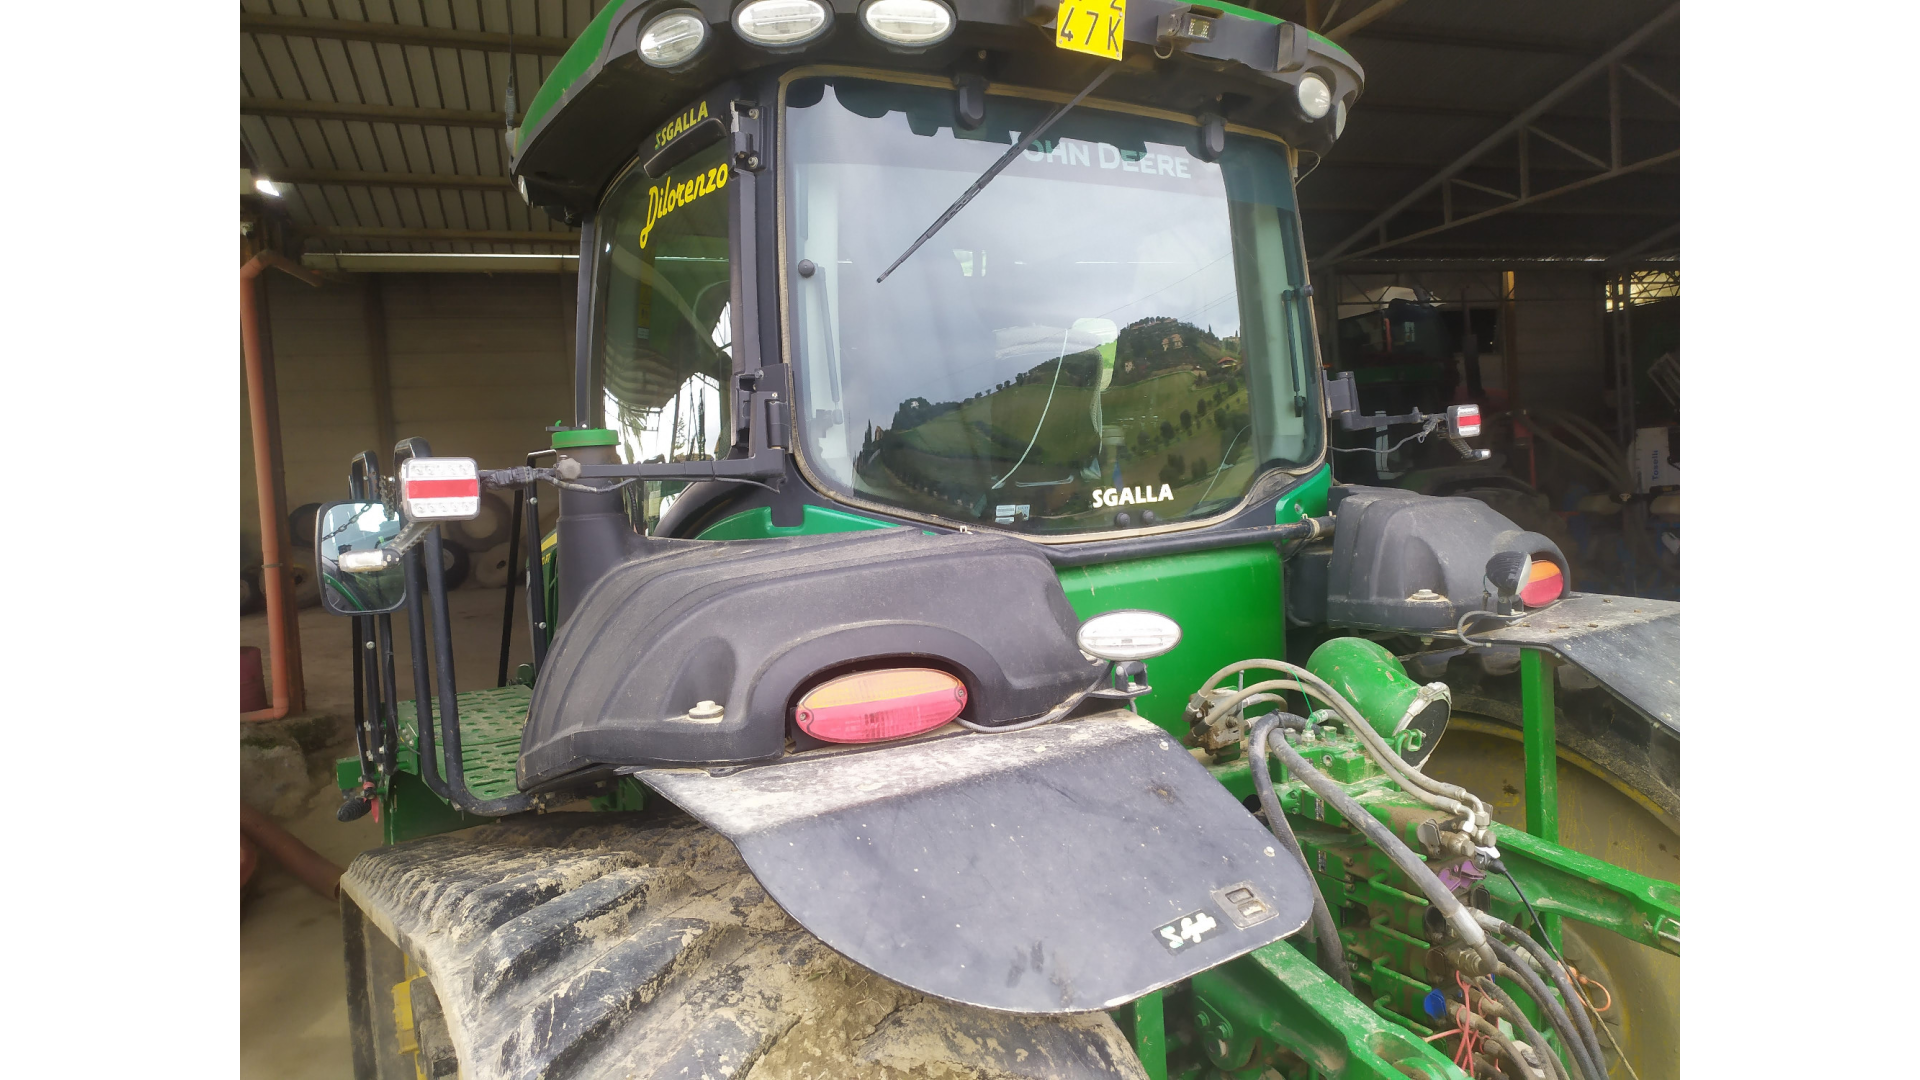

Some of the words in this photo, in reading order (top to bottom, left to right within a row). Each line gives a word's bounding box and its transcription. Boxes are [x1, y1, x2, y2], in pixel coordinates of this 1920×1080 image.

[1004, 138, 1091, 168] OHN
[1097, 141, 1192, 179] DEERE
[639, 163, 729, 249] Dilorenzo
[1091, 483, 1175, 509] SGALLA
